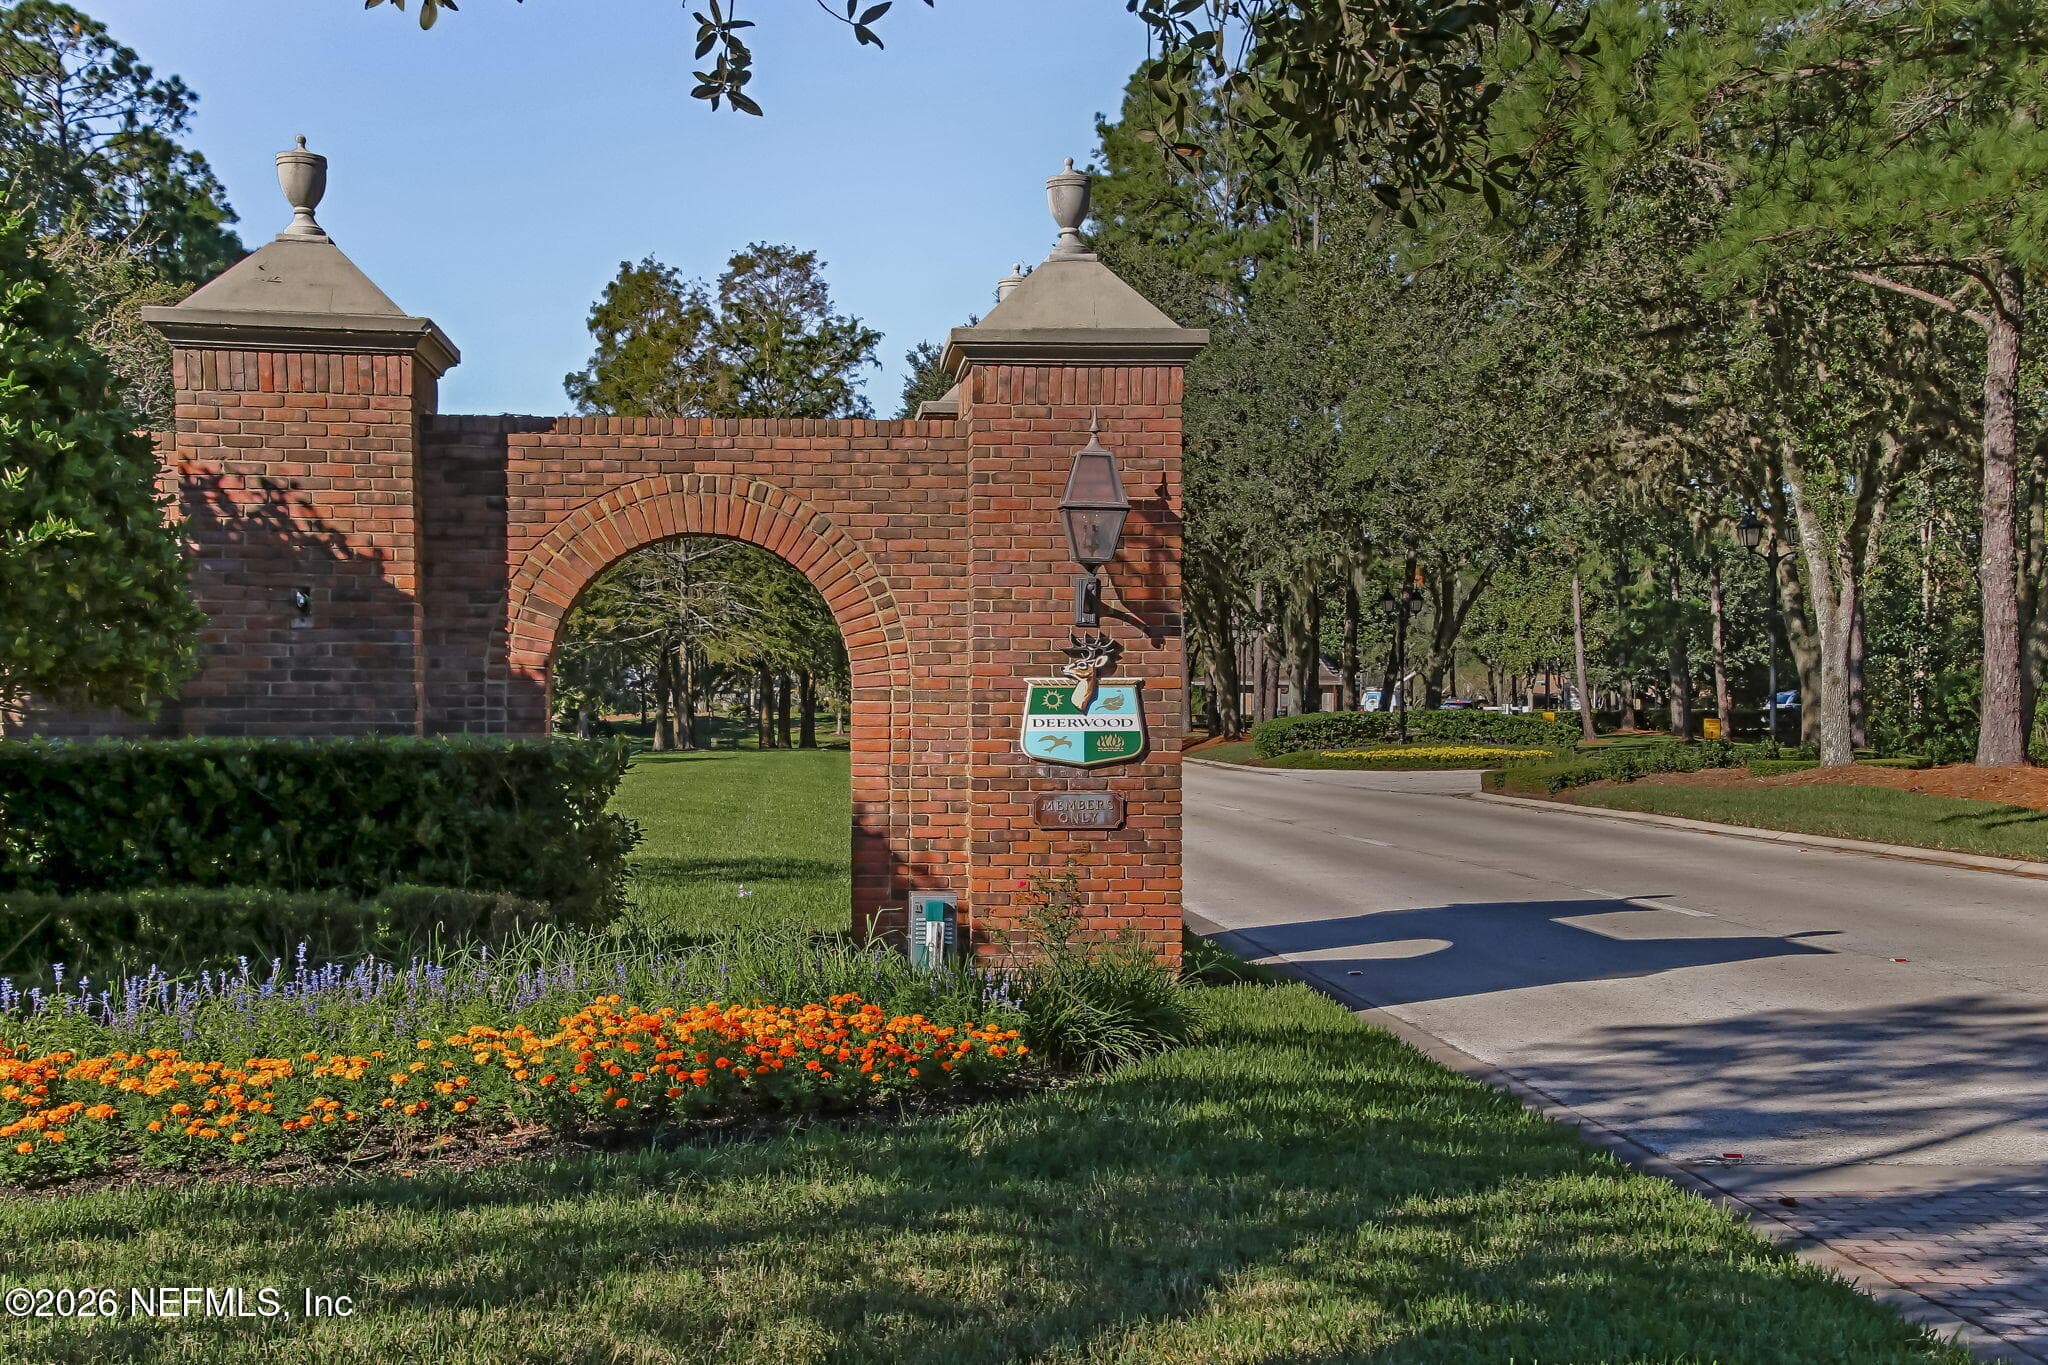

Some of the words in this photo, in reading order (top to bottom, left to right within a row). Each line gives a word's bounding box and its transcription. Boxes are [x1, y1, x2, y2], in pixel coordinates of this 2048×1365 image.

[1032, 718, 1134, 728] DEERWOOD
[1041, 799, 1115, 811] MEMBERS
[1058, 812, 1099, 824] ONLY
